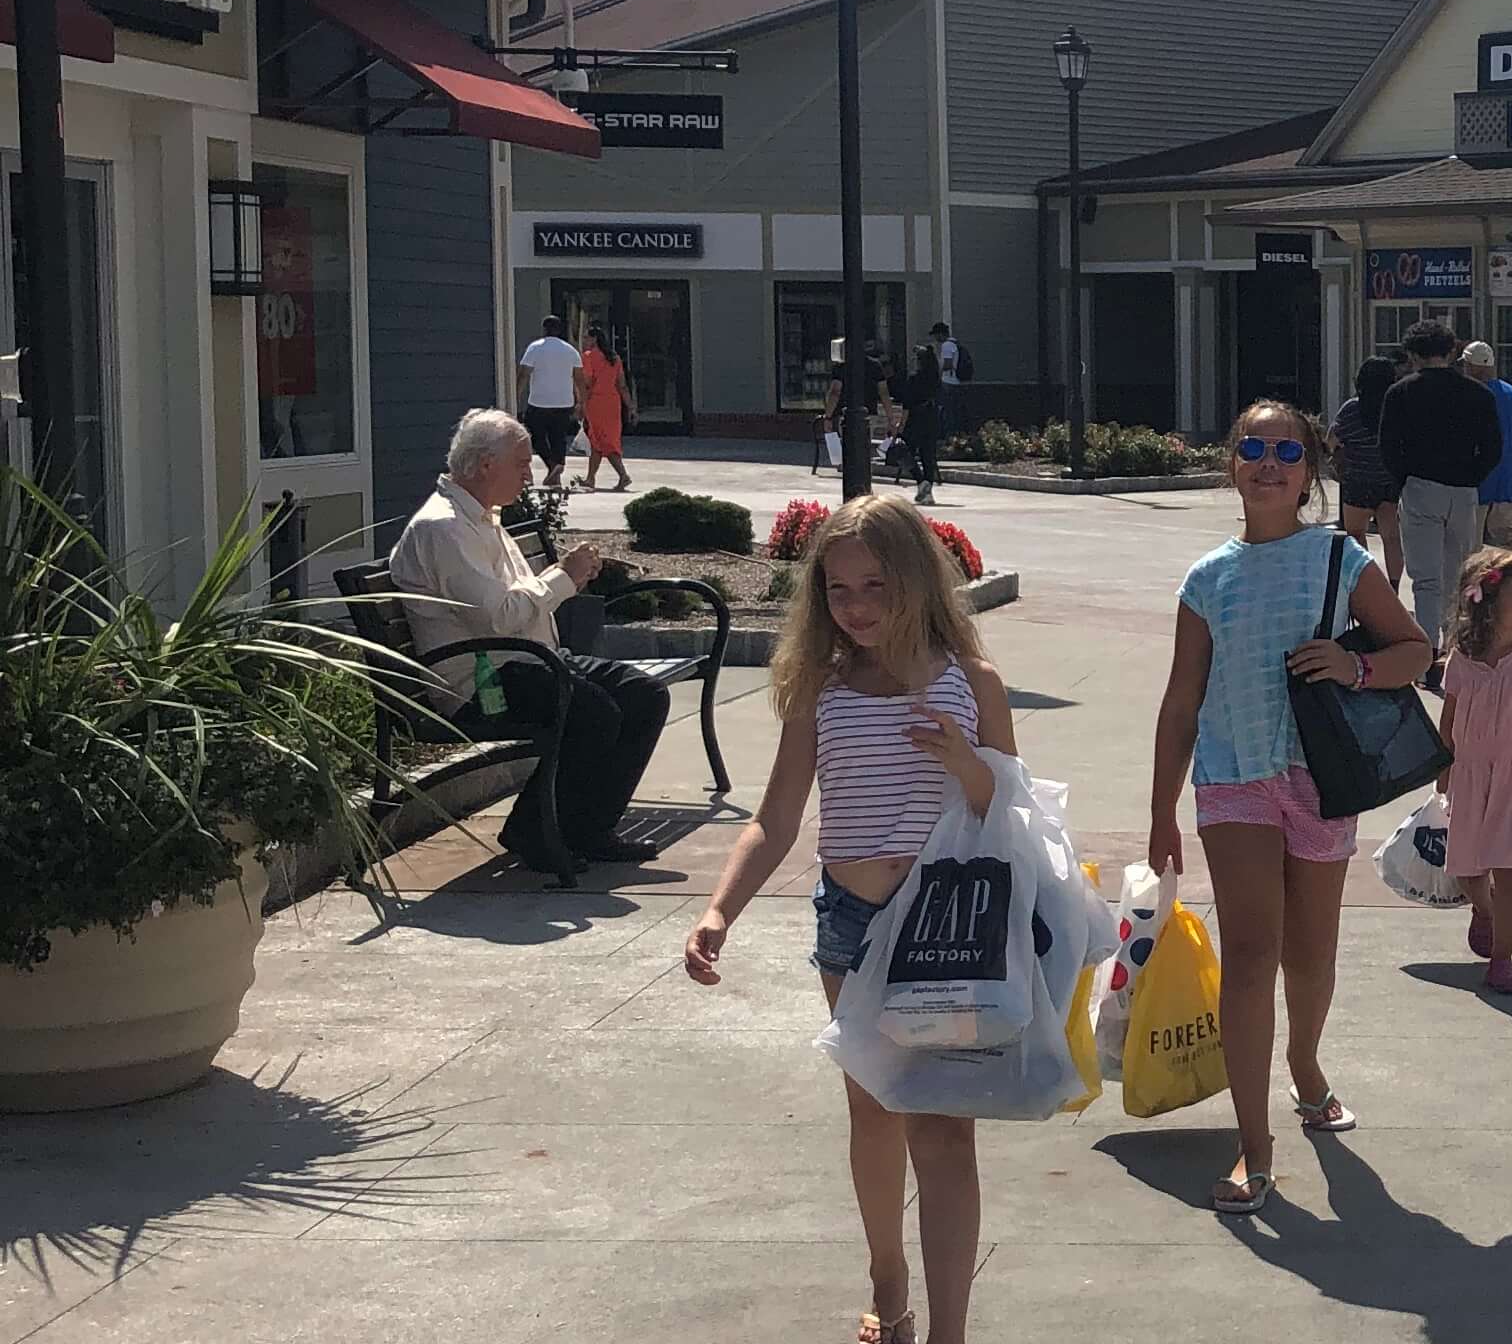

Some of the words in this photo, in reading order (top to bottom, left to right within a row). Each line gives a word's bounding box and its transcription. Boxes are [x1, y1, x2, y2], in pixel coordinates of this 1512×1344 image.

[669, 114, 720, 129] RAW
[538, 232, 613, 248] YANKEE
[617, 232, 693, 249] CANDLE
[1262, 252, 1309, 263] DIESEL
[1424, 274, 1472, 287] PRETZELS
[913, 877, 991, 944] GAP
[906, 947, 983, 964] FACTORY
